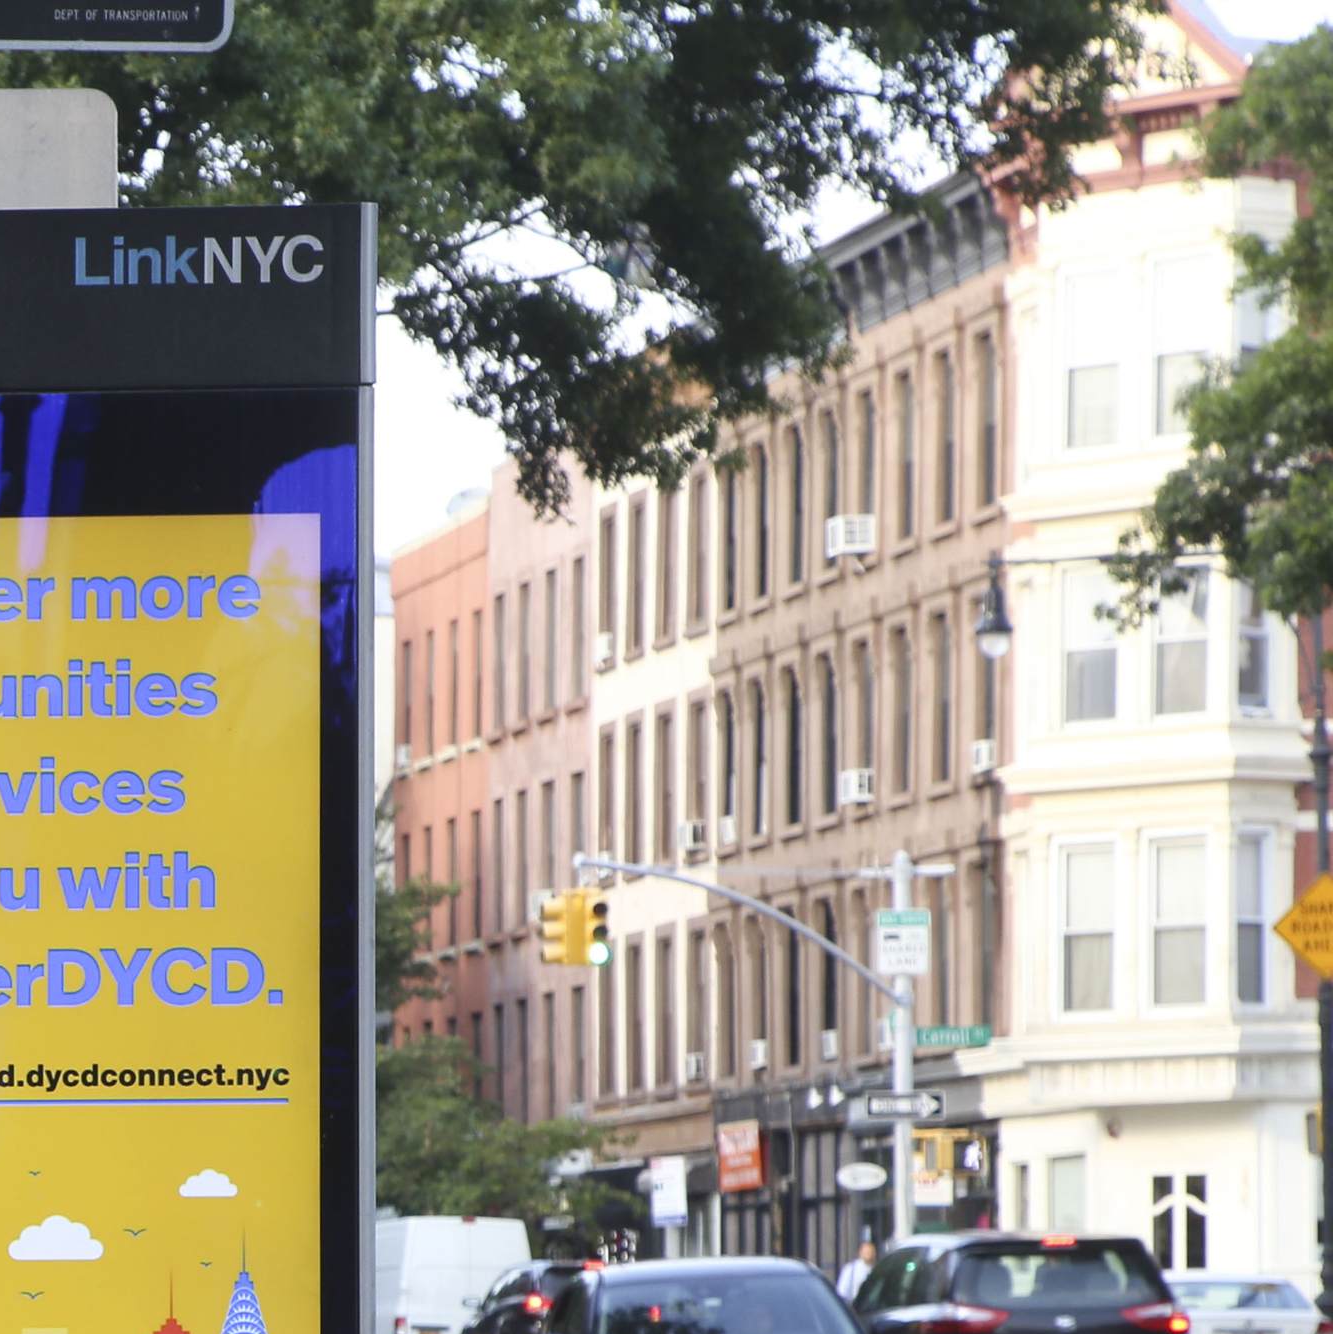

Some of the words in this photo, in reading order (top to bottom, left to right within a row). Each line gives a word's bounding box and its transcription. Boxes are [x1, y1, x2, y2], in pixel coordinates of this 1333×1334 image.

[54, 9, 82, 21] DEPT
[85, 10, 100, 21] OF
[103, 9, 189, 22] TRANSPORTATION
[74, 234, 325, 286] LinkNYC
[71, 573, 261, 620] more
[57, 851, 216, 911] with
[921, 1028, 970, 1045] Carroll
